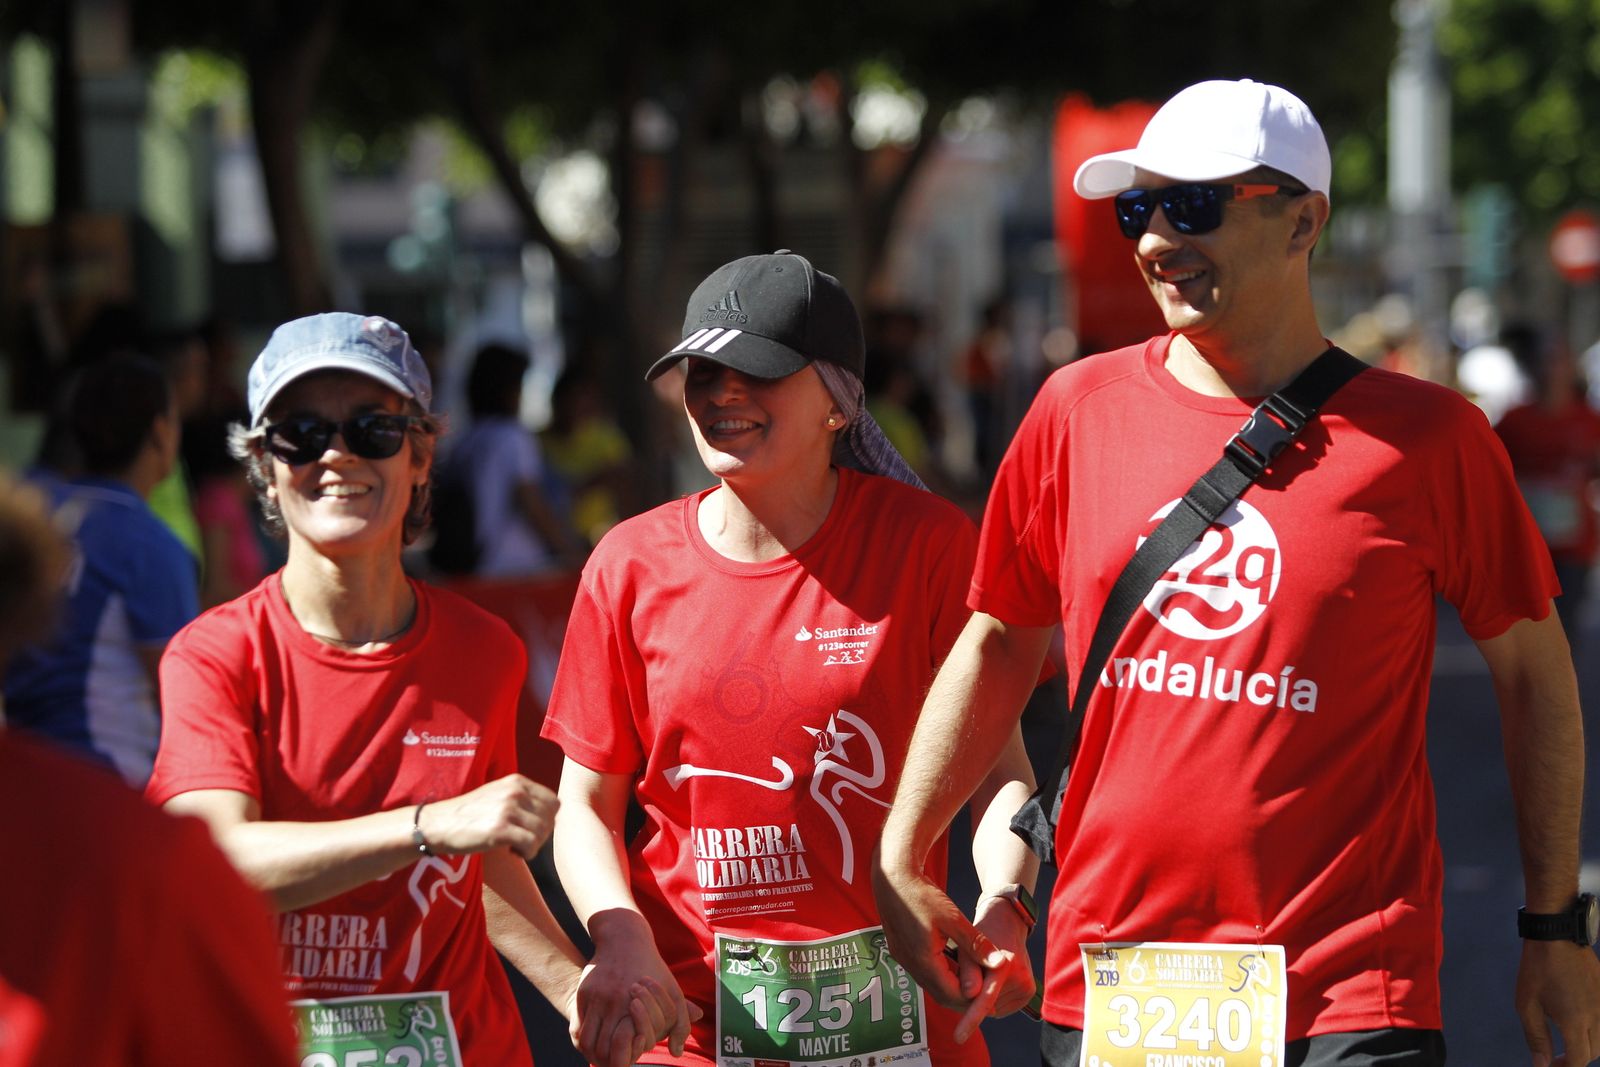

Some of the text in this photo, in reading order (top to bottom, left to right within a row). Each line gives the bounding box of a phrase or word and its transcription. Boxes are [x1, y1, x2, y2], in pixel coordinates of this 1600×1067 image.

[700, 310, 748, 324] adidas
[814, 624, 878, 640] Santander
[818, 641, 869, 652] #123acorrer
[691, 823, 806, 859] ARRERA
[695, 854, 811, 889] OLIDARIA
[772, 883, 814, 895] FRECUENTES
[281, 912, 388, 950] RRERA
[789, 941, 859, 962] CARRERA
[726, 959, 752, 976] 2019
[789, 954, 861, 974] SOLIDARIA
[1155, 953, 1224, 970] CARRERA
[1095, 969, 1120, 987] 2019
[1156, 967, 1224, 983] SOLIDARIA
[741, 975, 884, 1033] 1251
[311, 1005, 386, 1024] CARRERA
[1106, 994, 1252, 1053] 3240
[312, 1019, 387, 1037] SOLIDARIA
[724, 1035, 743, 1054] 3k
[799, 1033, 850, 1057] MAYTE
